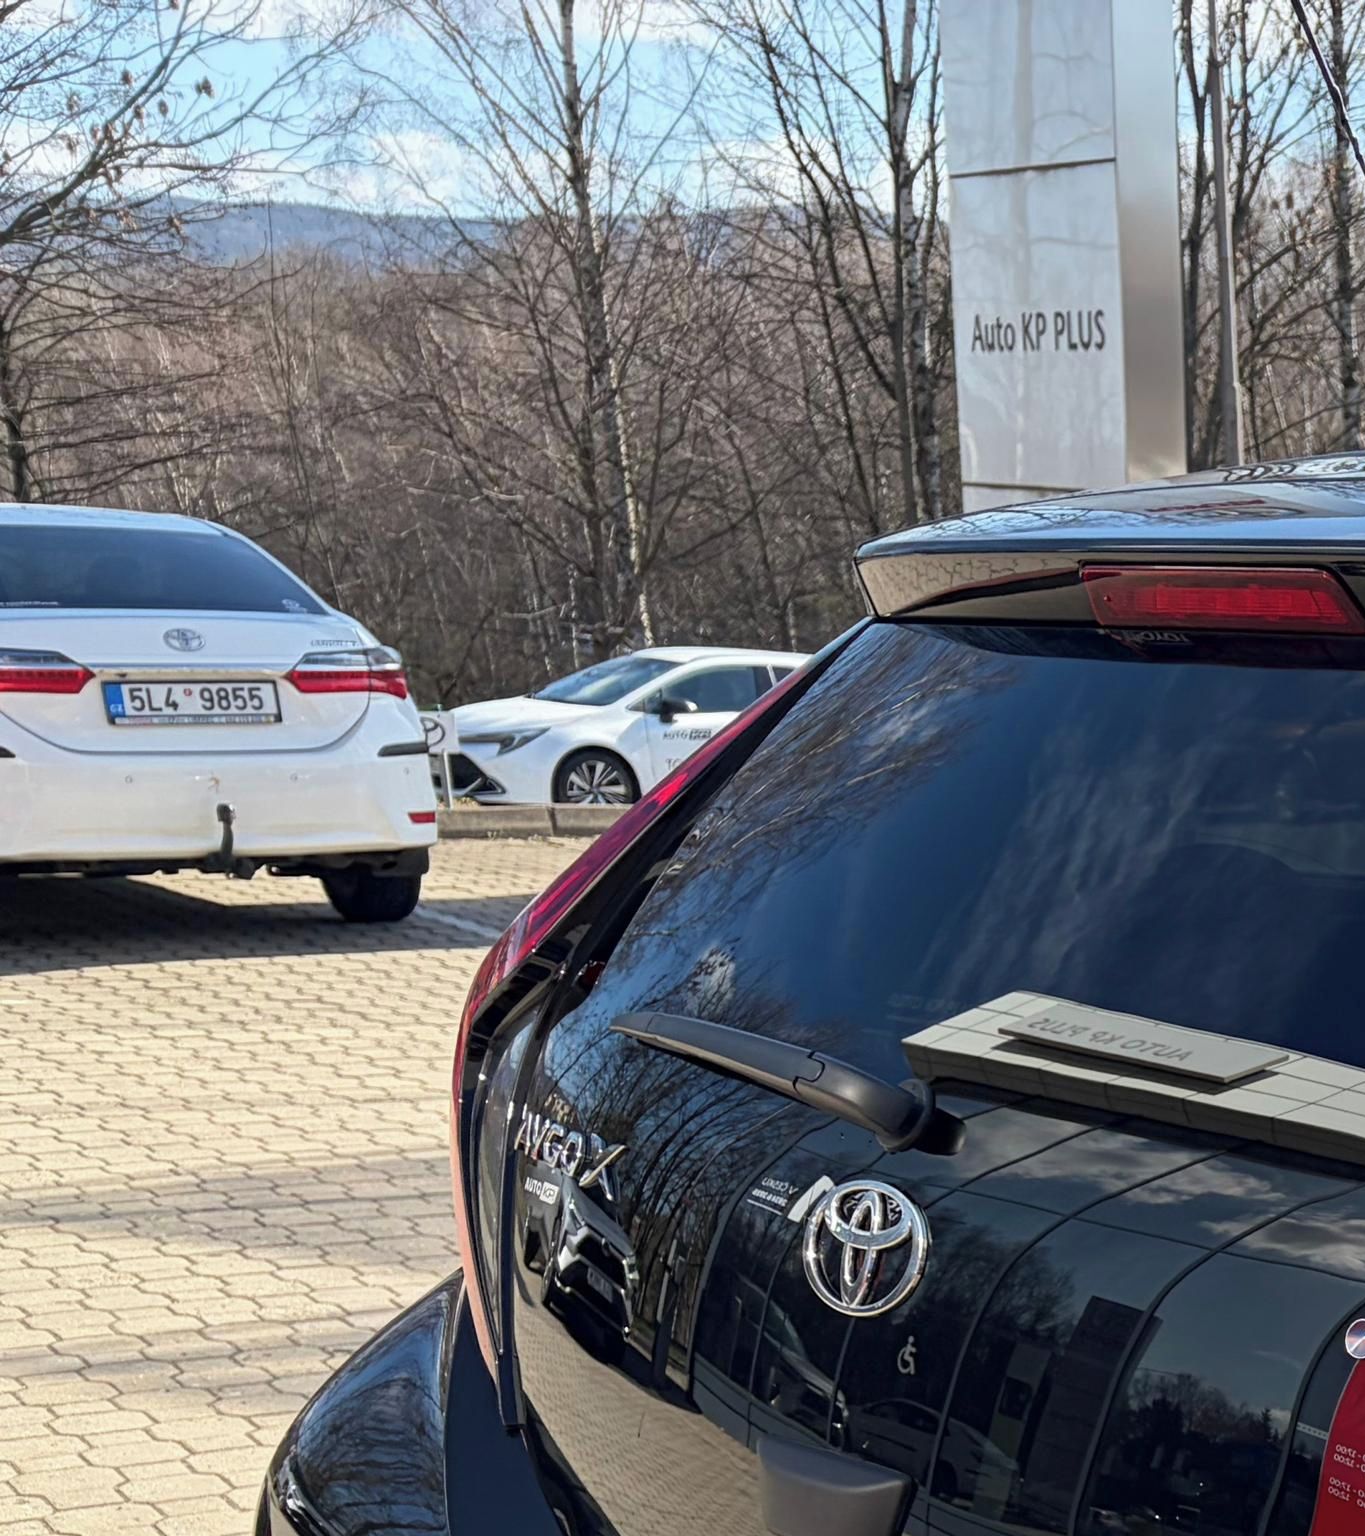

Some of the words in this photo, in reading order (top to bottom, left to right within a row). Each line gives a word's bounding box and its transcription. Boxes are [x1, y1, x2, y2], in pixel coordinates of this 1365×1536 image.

[972, 313, 1016, 352] Auto
[1021, 311, 1047, 351] KP
[1053, 308, 1106, 351] PLUS
[128, 687, 179, 712] 5L4
[199, 687, 264, 711] 9855
[514, 1103, 583, 1177] AYGO
[579, 1132, 629, 1200] X
[524, 1177, 542, 1194] AUTO
